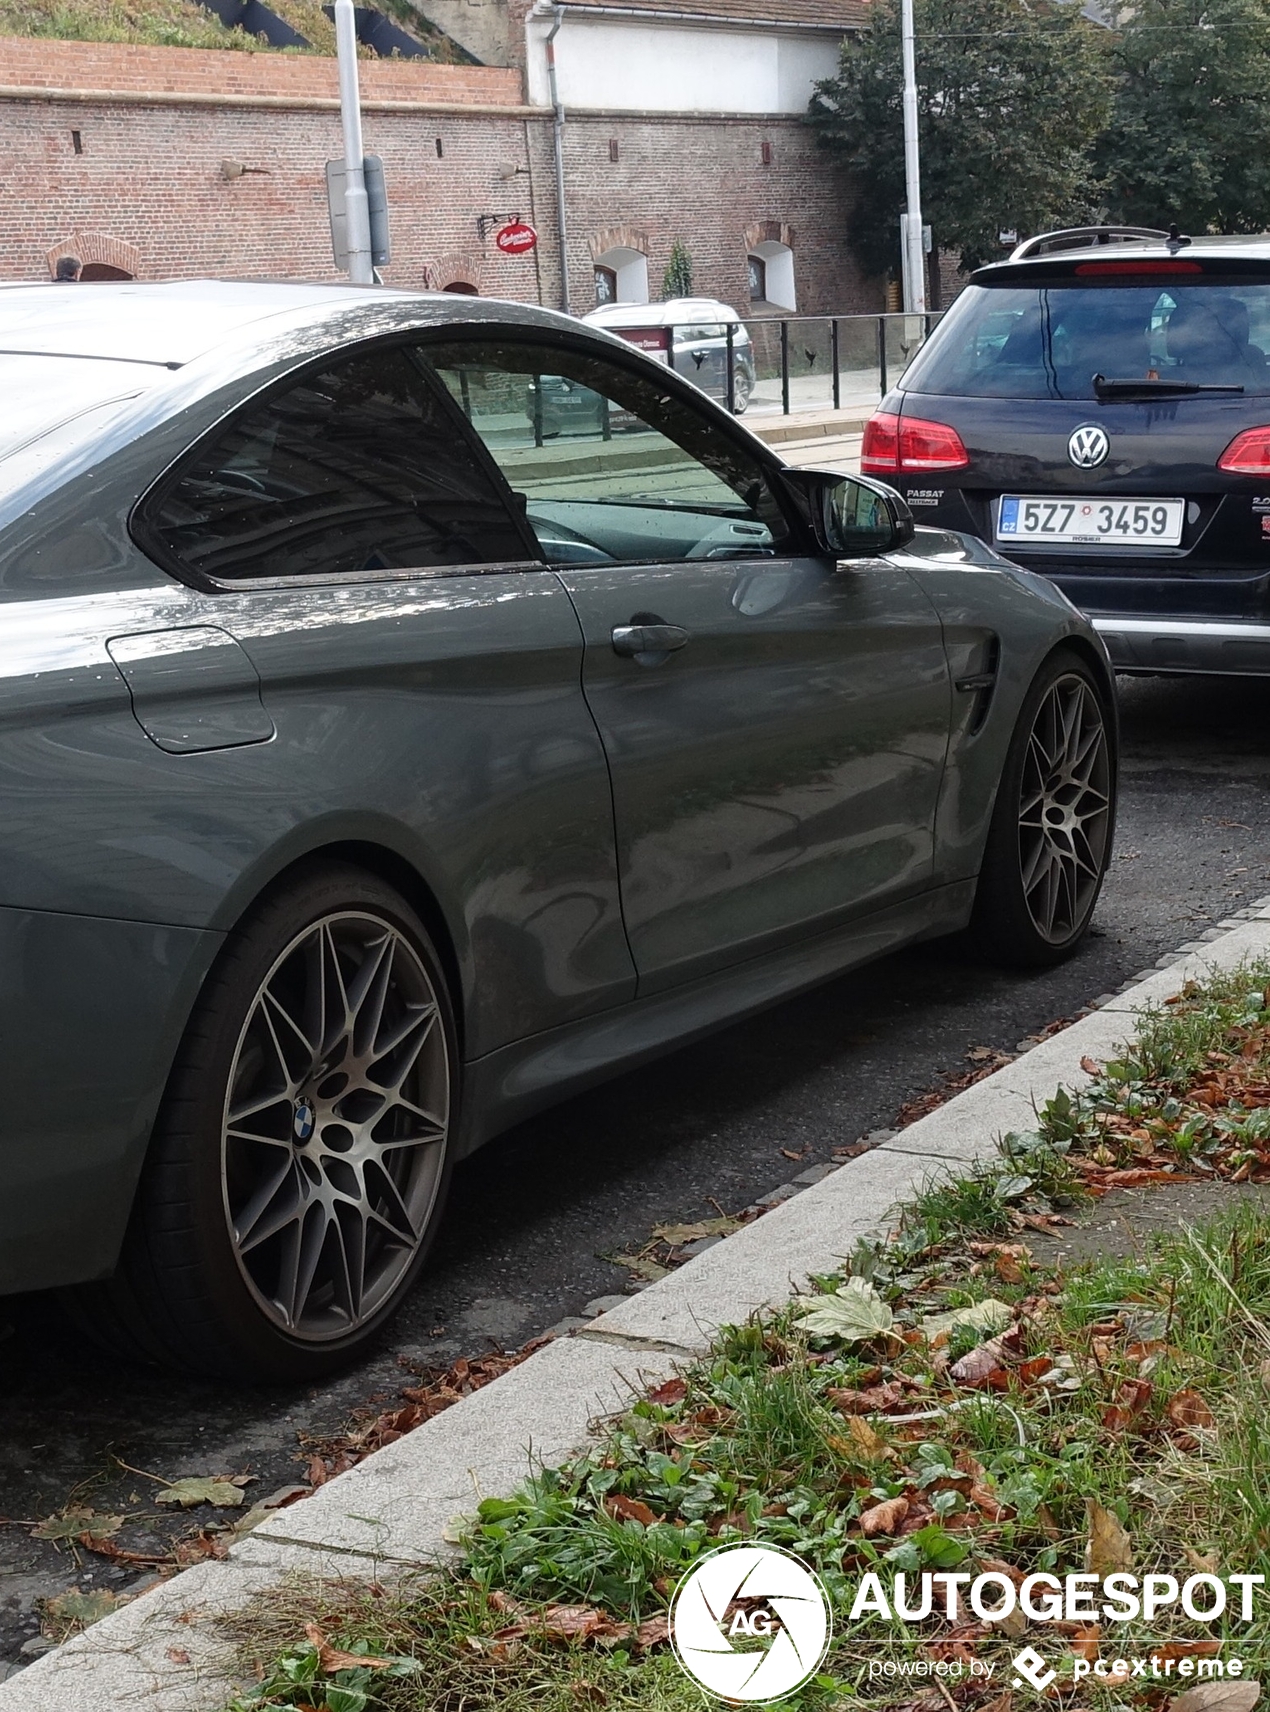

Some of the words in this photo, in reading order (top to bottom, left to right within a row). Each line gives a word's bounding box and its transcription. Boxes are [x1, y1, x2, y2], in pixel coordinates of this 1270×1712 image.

[906, 489, 945, 498] PASSAT
[1024, 503, 1076, 533] 5Z7
[1097, 505, 1168, 535] 3459
[1002, 522, 1016, 532] CZ
